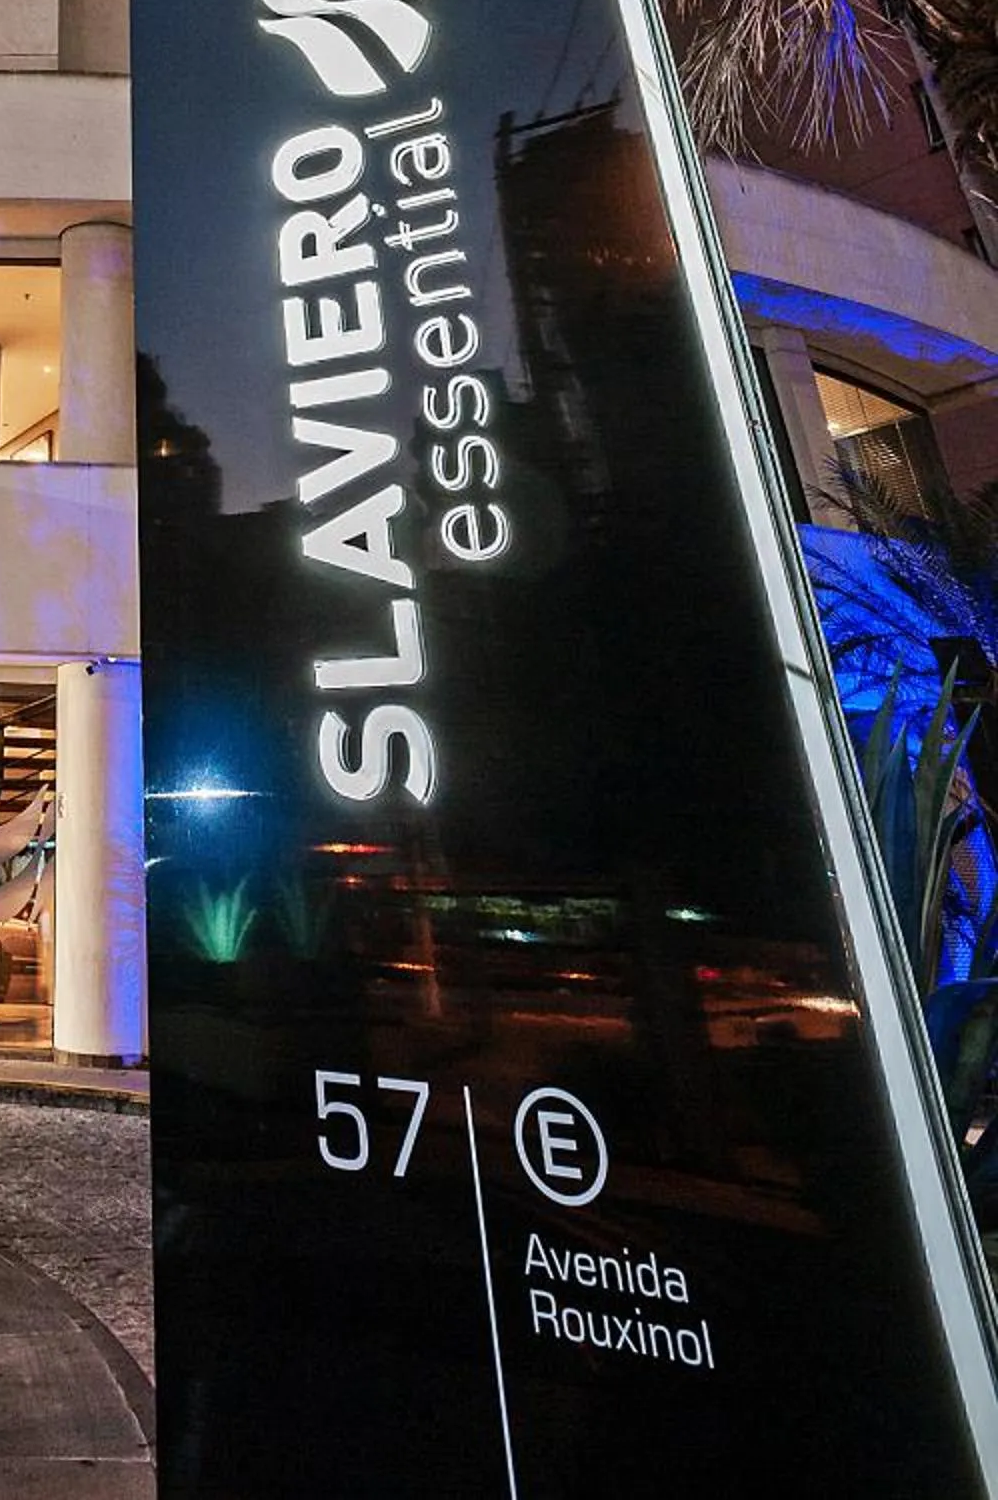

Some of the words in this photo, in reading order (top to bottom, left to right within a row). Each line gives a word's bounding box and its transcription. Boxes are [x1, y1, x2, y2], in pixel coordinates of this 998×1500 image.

[364, 96, 508, 562] essential
[271, 124, 438, 805] SLAVIERO
[315, 1070, 430, 1177] 57
[524, 1234, 690, 1304] Avenida
[530, 1288, 715, 1370] Rouxinol
